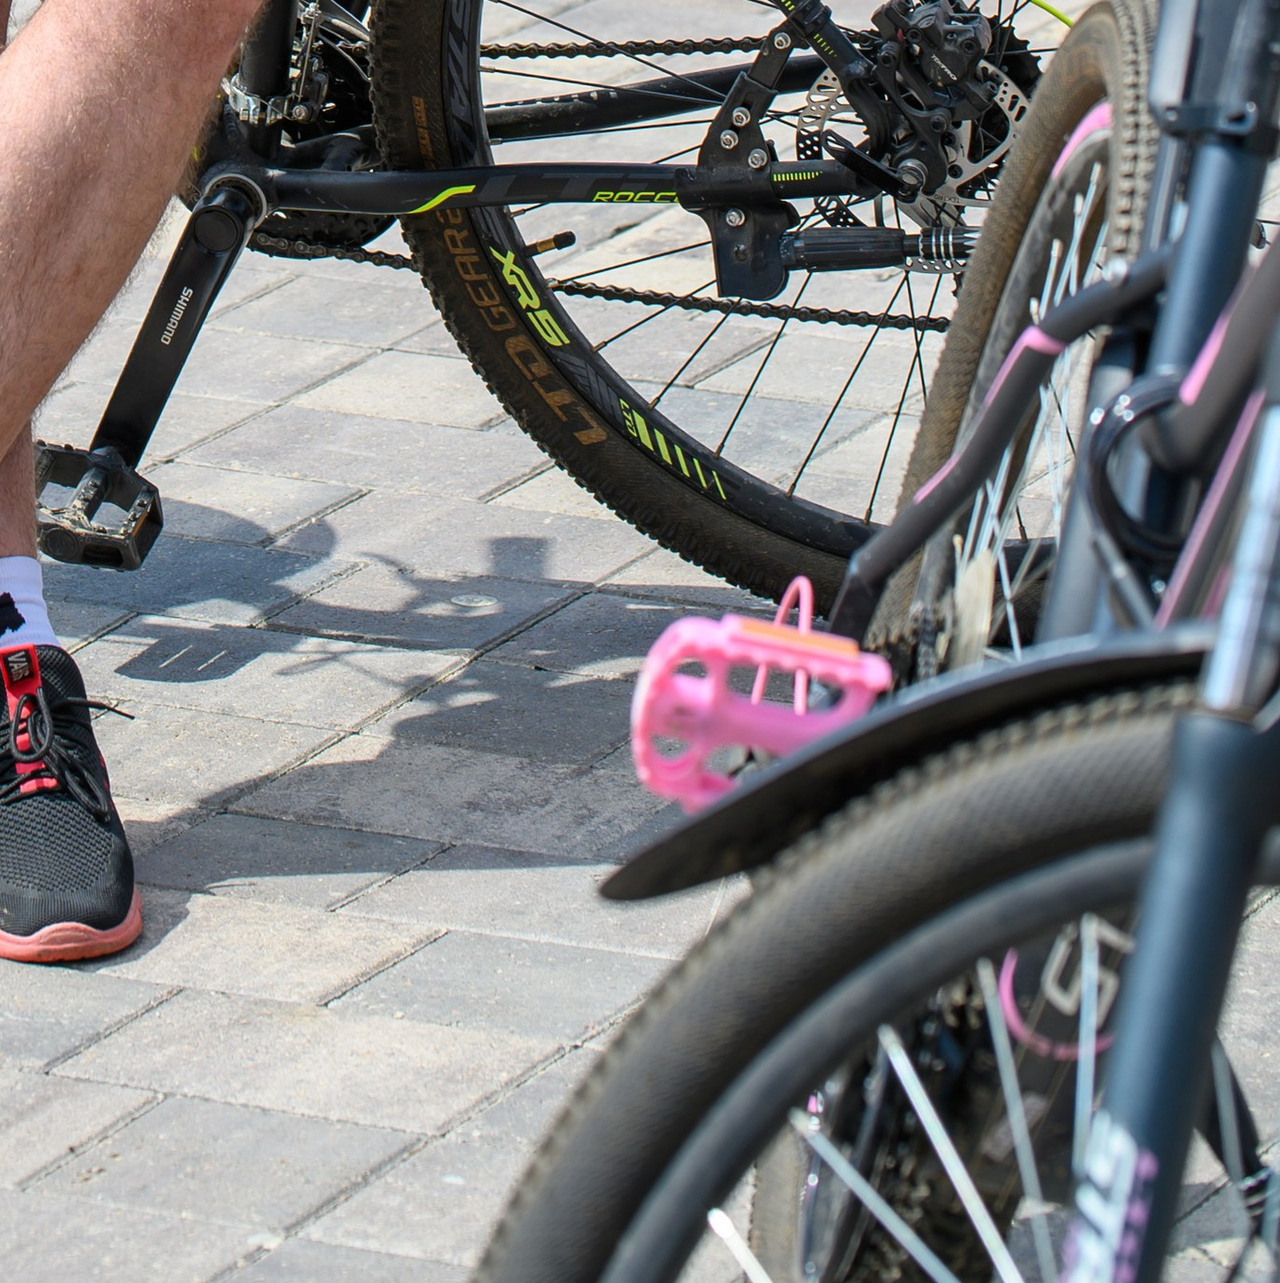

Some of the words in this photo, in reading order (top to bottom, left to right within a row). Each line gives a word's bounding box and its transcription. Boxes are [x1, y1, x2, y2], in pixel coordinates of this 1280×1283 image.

[592, 191, 680, 203] ROCC
[160, 286, 194, 345] SHIMANO
[505, 334, 608, 445] LTD
